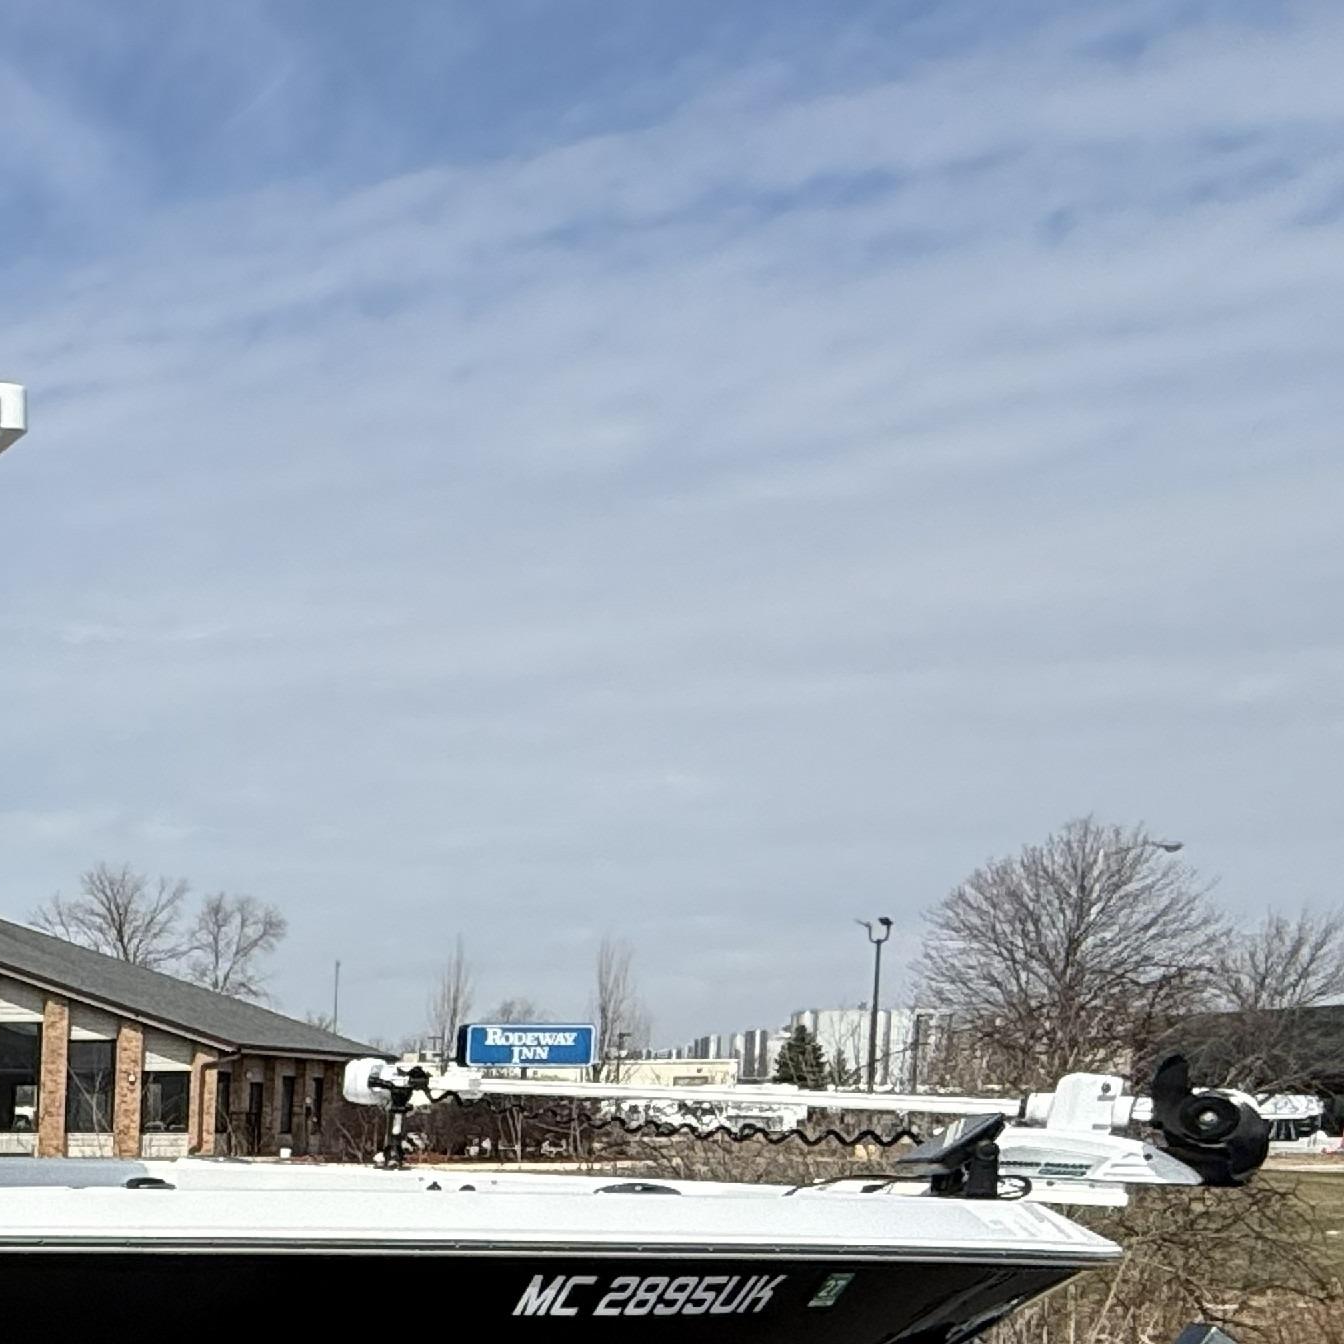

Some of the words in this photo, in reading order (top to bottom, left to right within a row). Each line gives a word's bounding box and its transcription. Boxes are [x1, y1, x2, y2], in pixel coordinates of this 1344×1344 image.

[484, 1027, 578, 1046] RODEWAY
[511, 1045, 550, 1064] INN
[512, 1274, 599, 1317] MC
[592, 1274, 789, 1317] 2895UK
